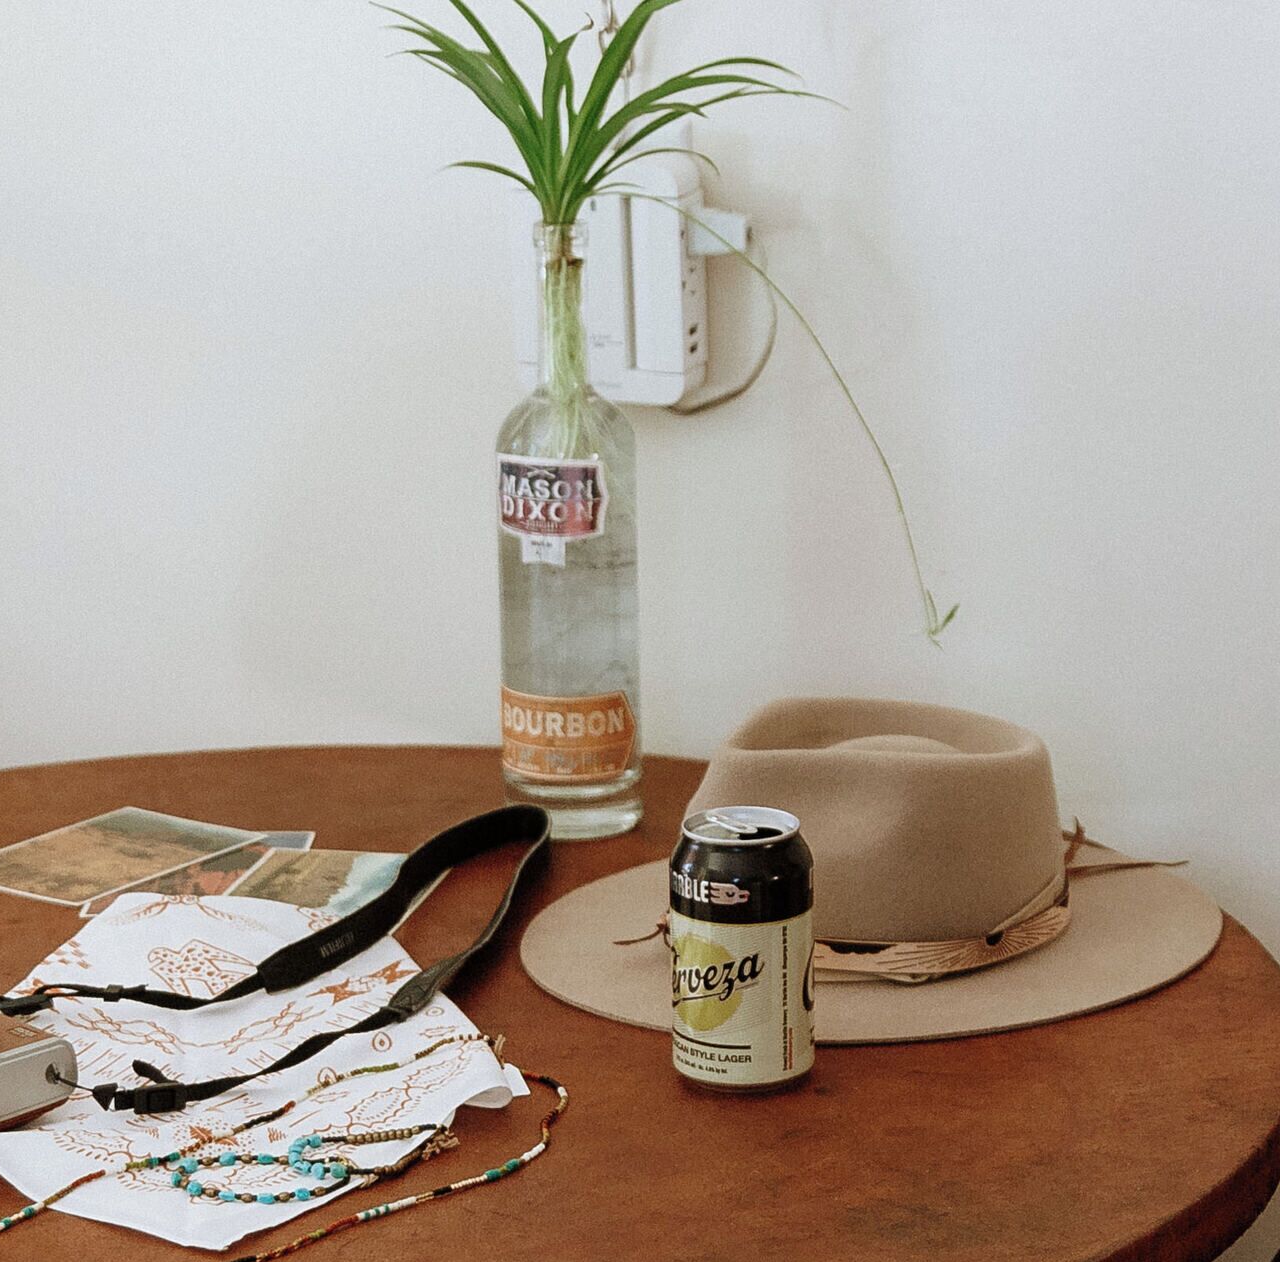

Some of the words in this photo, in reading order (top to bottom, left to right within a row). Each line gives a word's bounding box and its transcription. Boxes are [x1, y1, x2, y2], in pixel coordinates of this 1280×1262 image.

[500, 473, 594, 500] MASON
[502, 495, 594, 522] DIXON
[503, 702, 625, 737] BOURBON
[672, 948, 765, 1005] erveza
[690, 1047, 716, 1061] STYLE
[718, 1055, 752, 1063] LAGER
